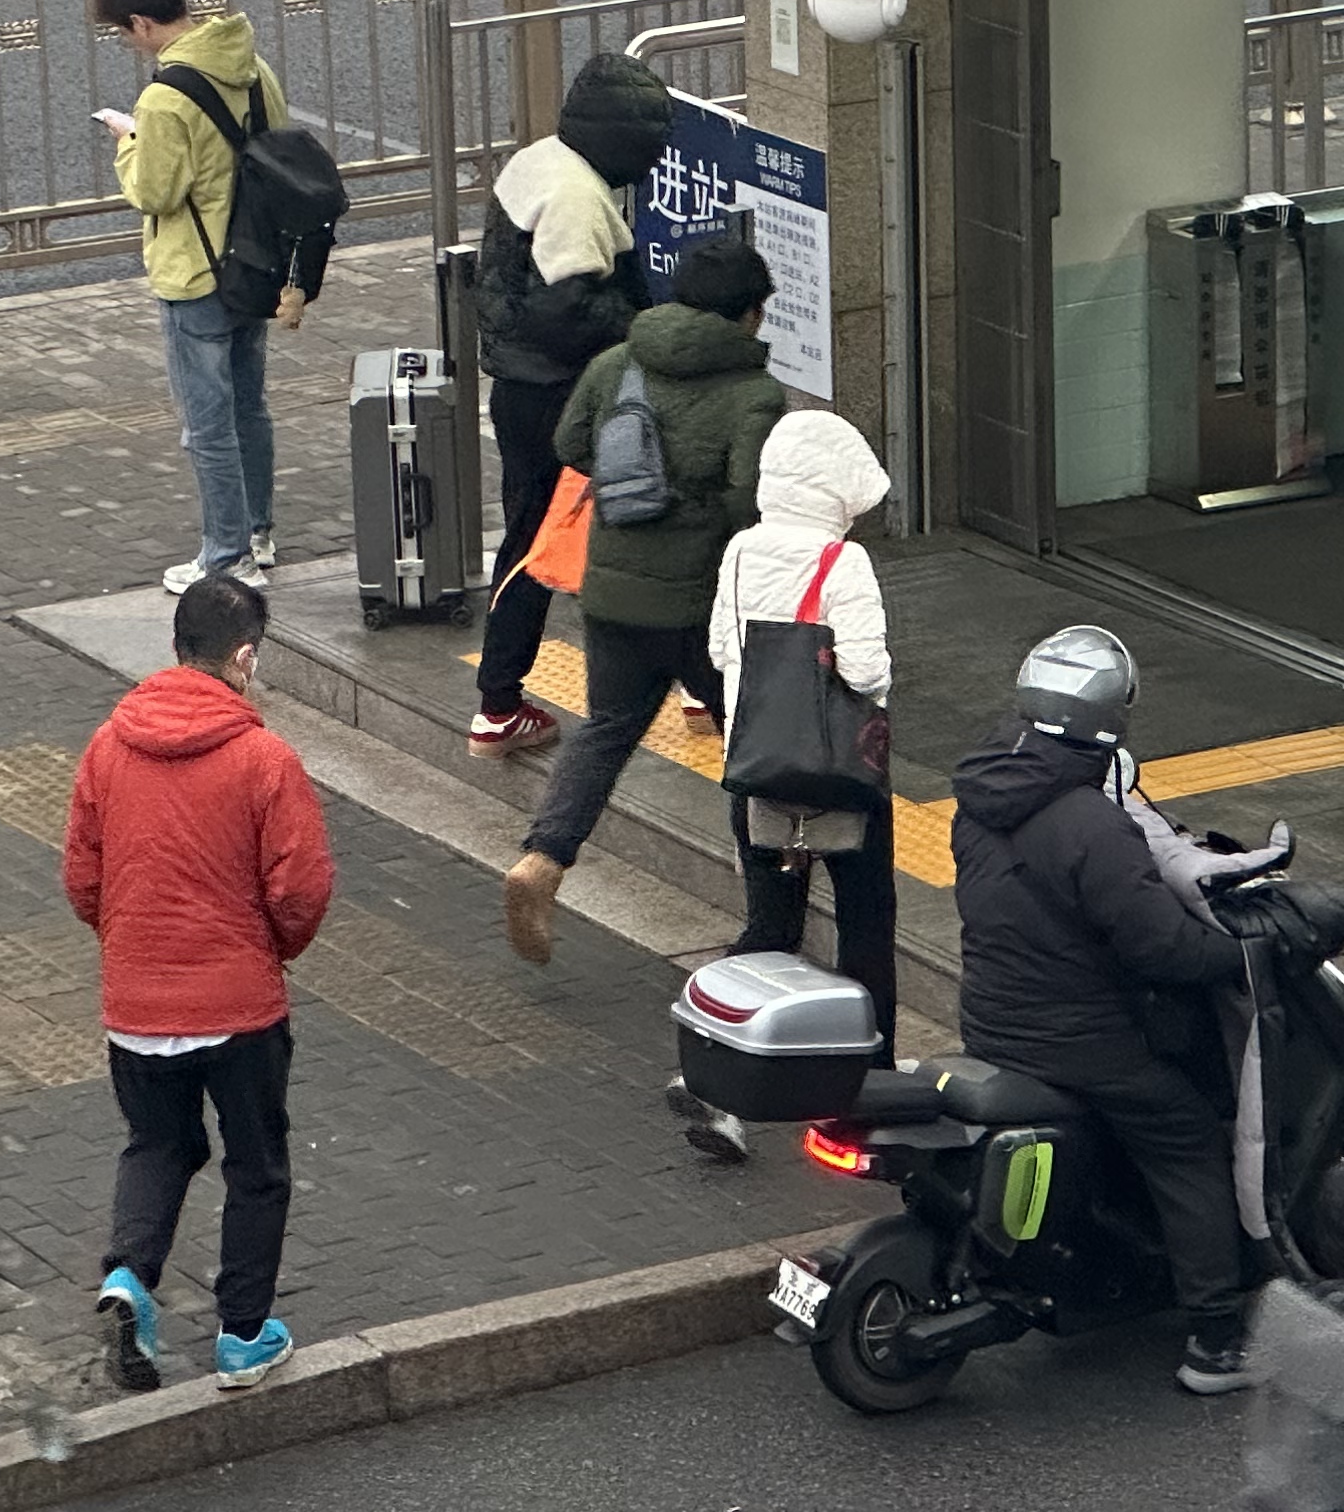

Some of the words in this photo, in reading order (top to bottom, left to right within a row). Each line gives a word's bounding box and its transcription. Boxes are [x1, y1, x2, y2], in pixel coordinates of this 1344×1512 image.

[755, 142, 805, 180] 温馨提示
[648, 144, 729, 223] 进站
[759, 171, 785, 192] WARM
[785, 179, 802, 197] TIPS
